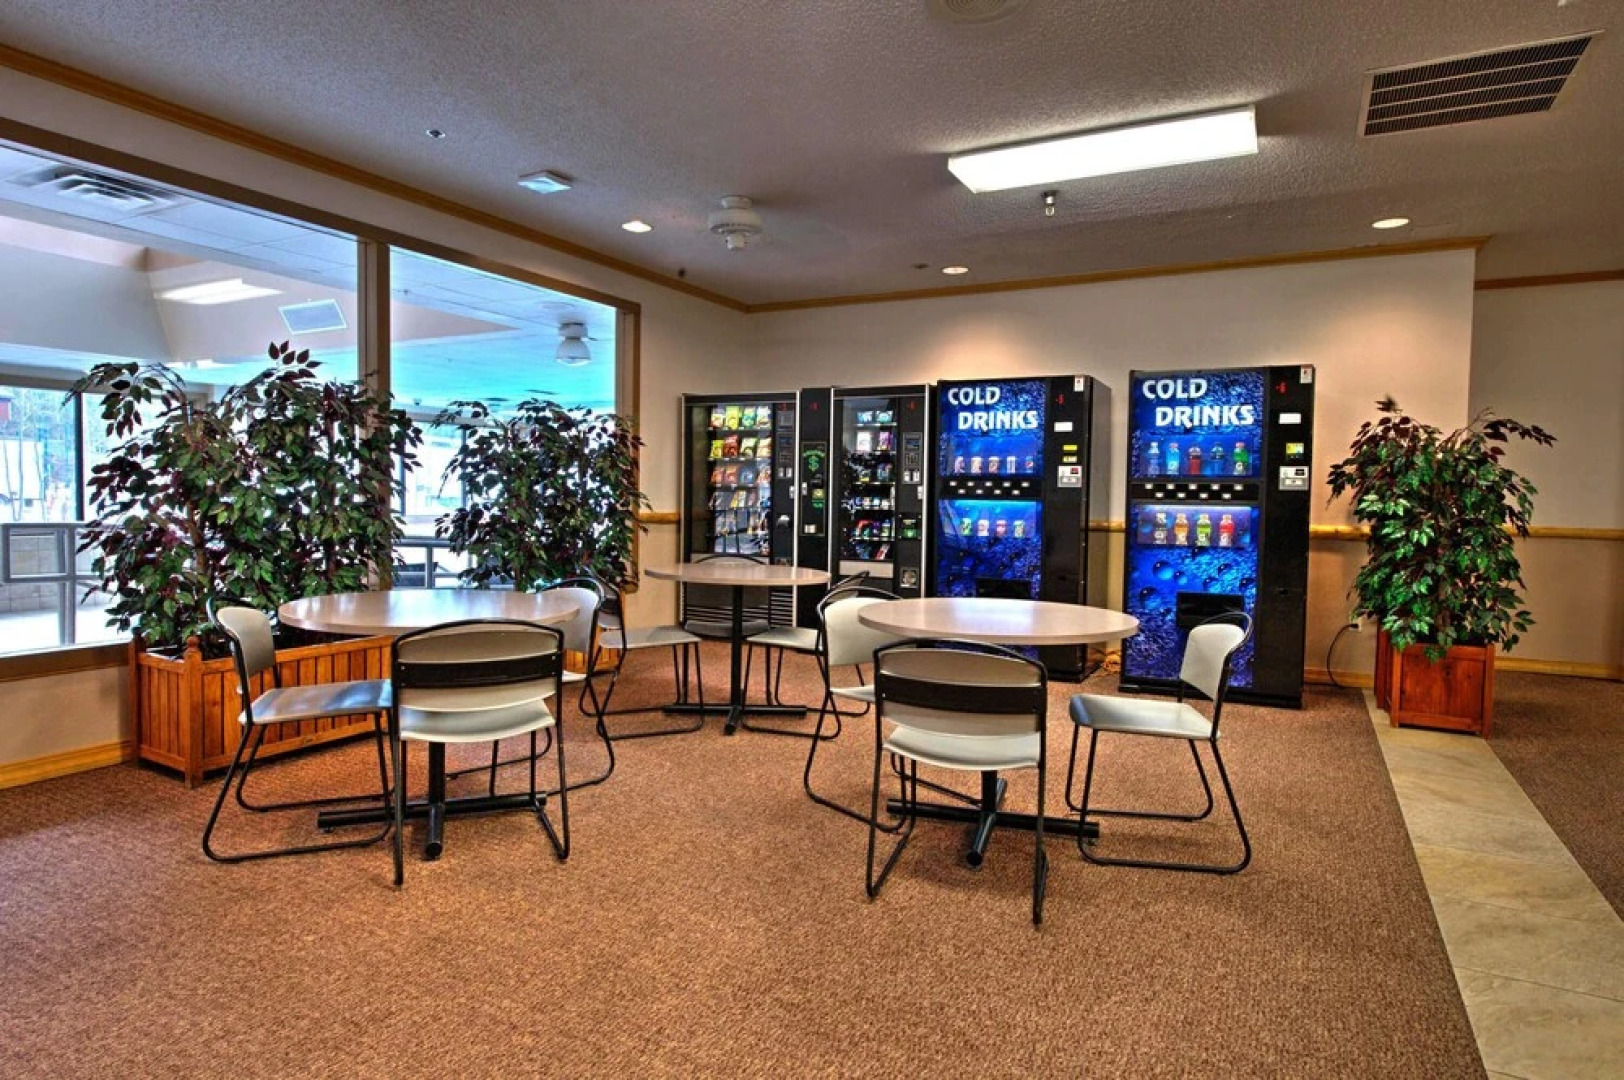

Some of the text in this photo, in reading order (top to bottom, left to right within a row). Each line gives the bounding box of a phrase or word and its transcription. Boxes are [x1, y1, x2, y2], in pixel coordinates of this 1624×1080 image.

[948, 387, 1001, 406] COLD
[1142, 378, 1208, 399] COLD
[958, 410, 1038, 431] DRINKS
[1155, 405, 1254, 428] DRINKS
